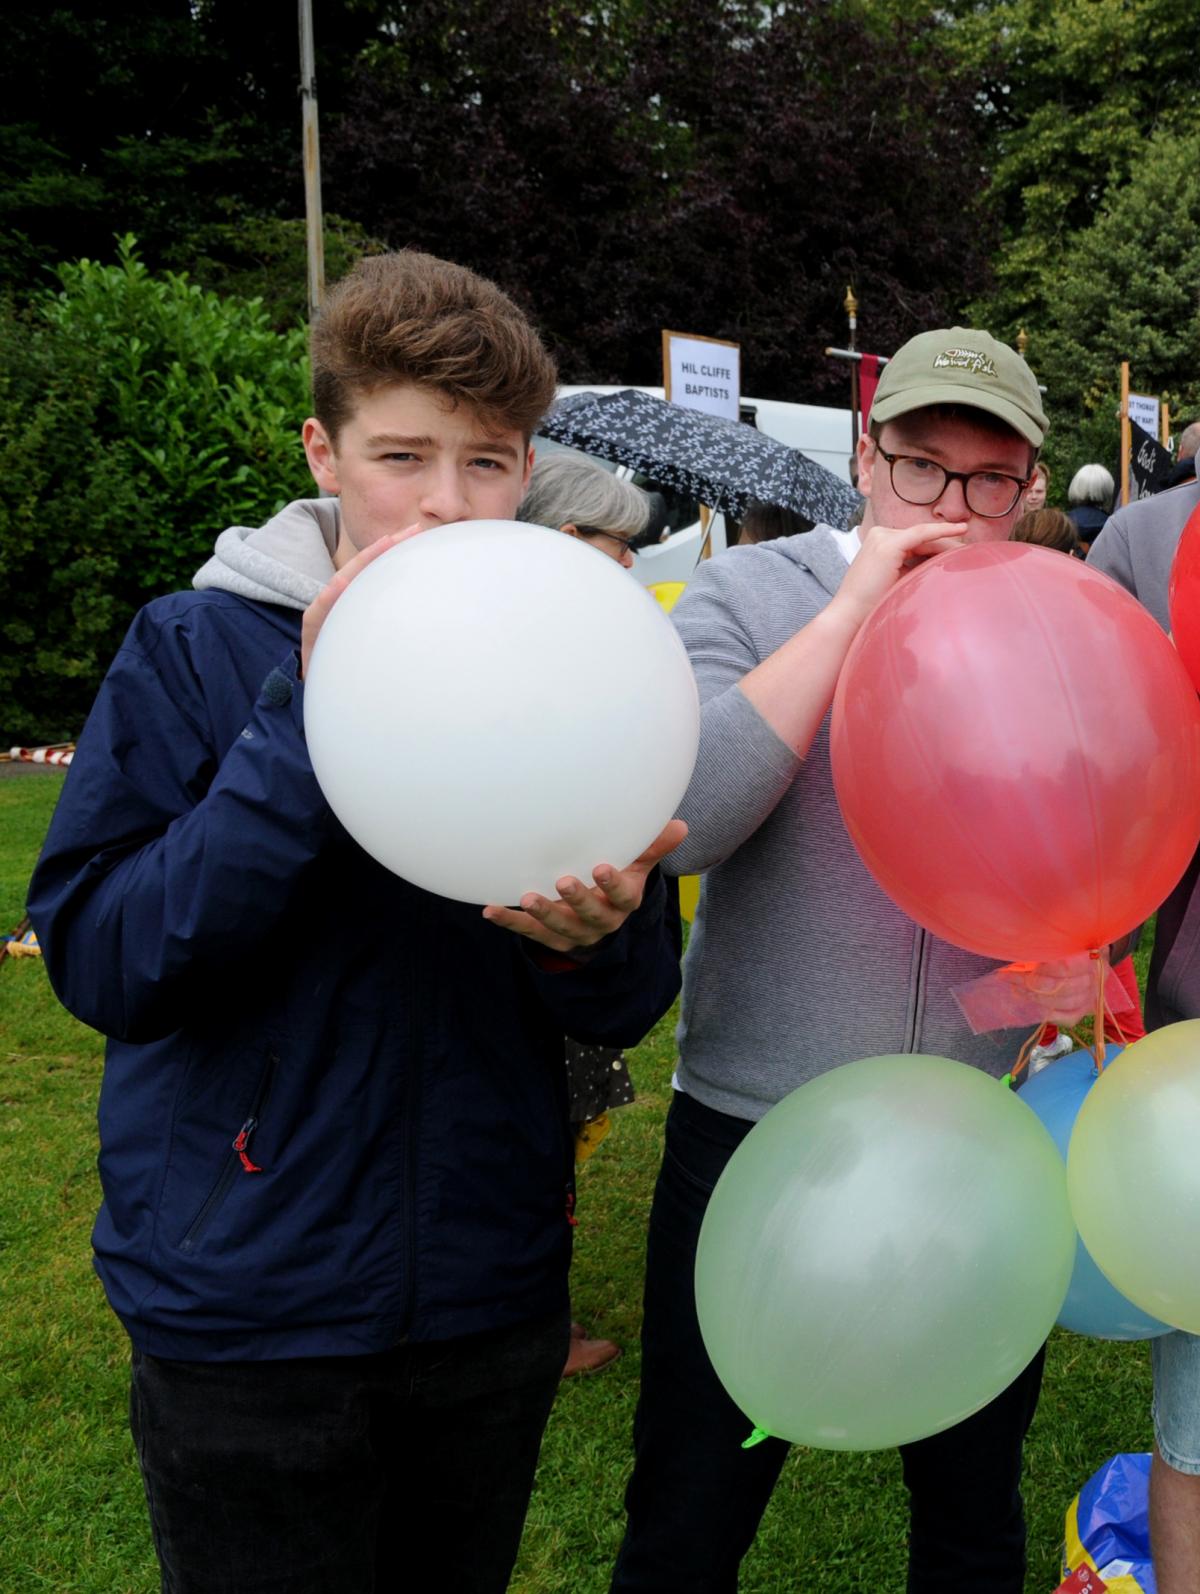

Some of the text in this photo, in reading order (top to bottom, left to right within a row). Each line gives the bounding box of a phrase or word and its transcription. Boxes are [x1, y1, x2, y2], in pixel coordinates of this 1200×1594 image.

[681, 362, 731, 380] HIL CLIFFE
[685, 383, 730, 400] BAPTISTS
